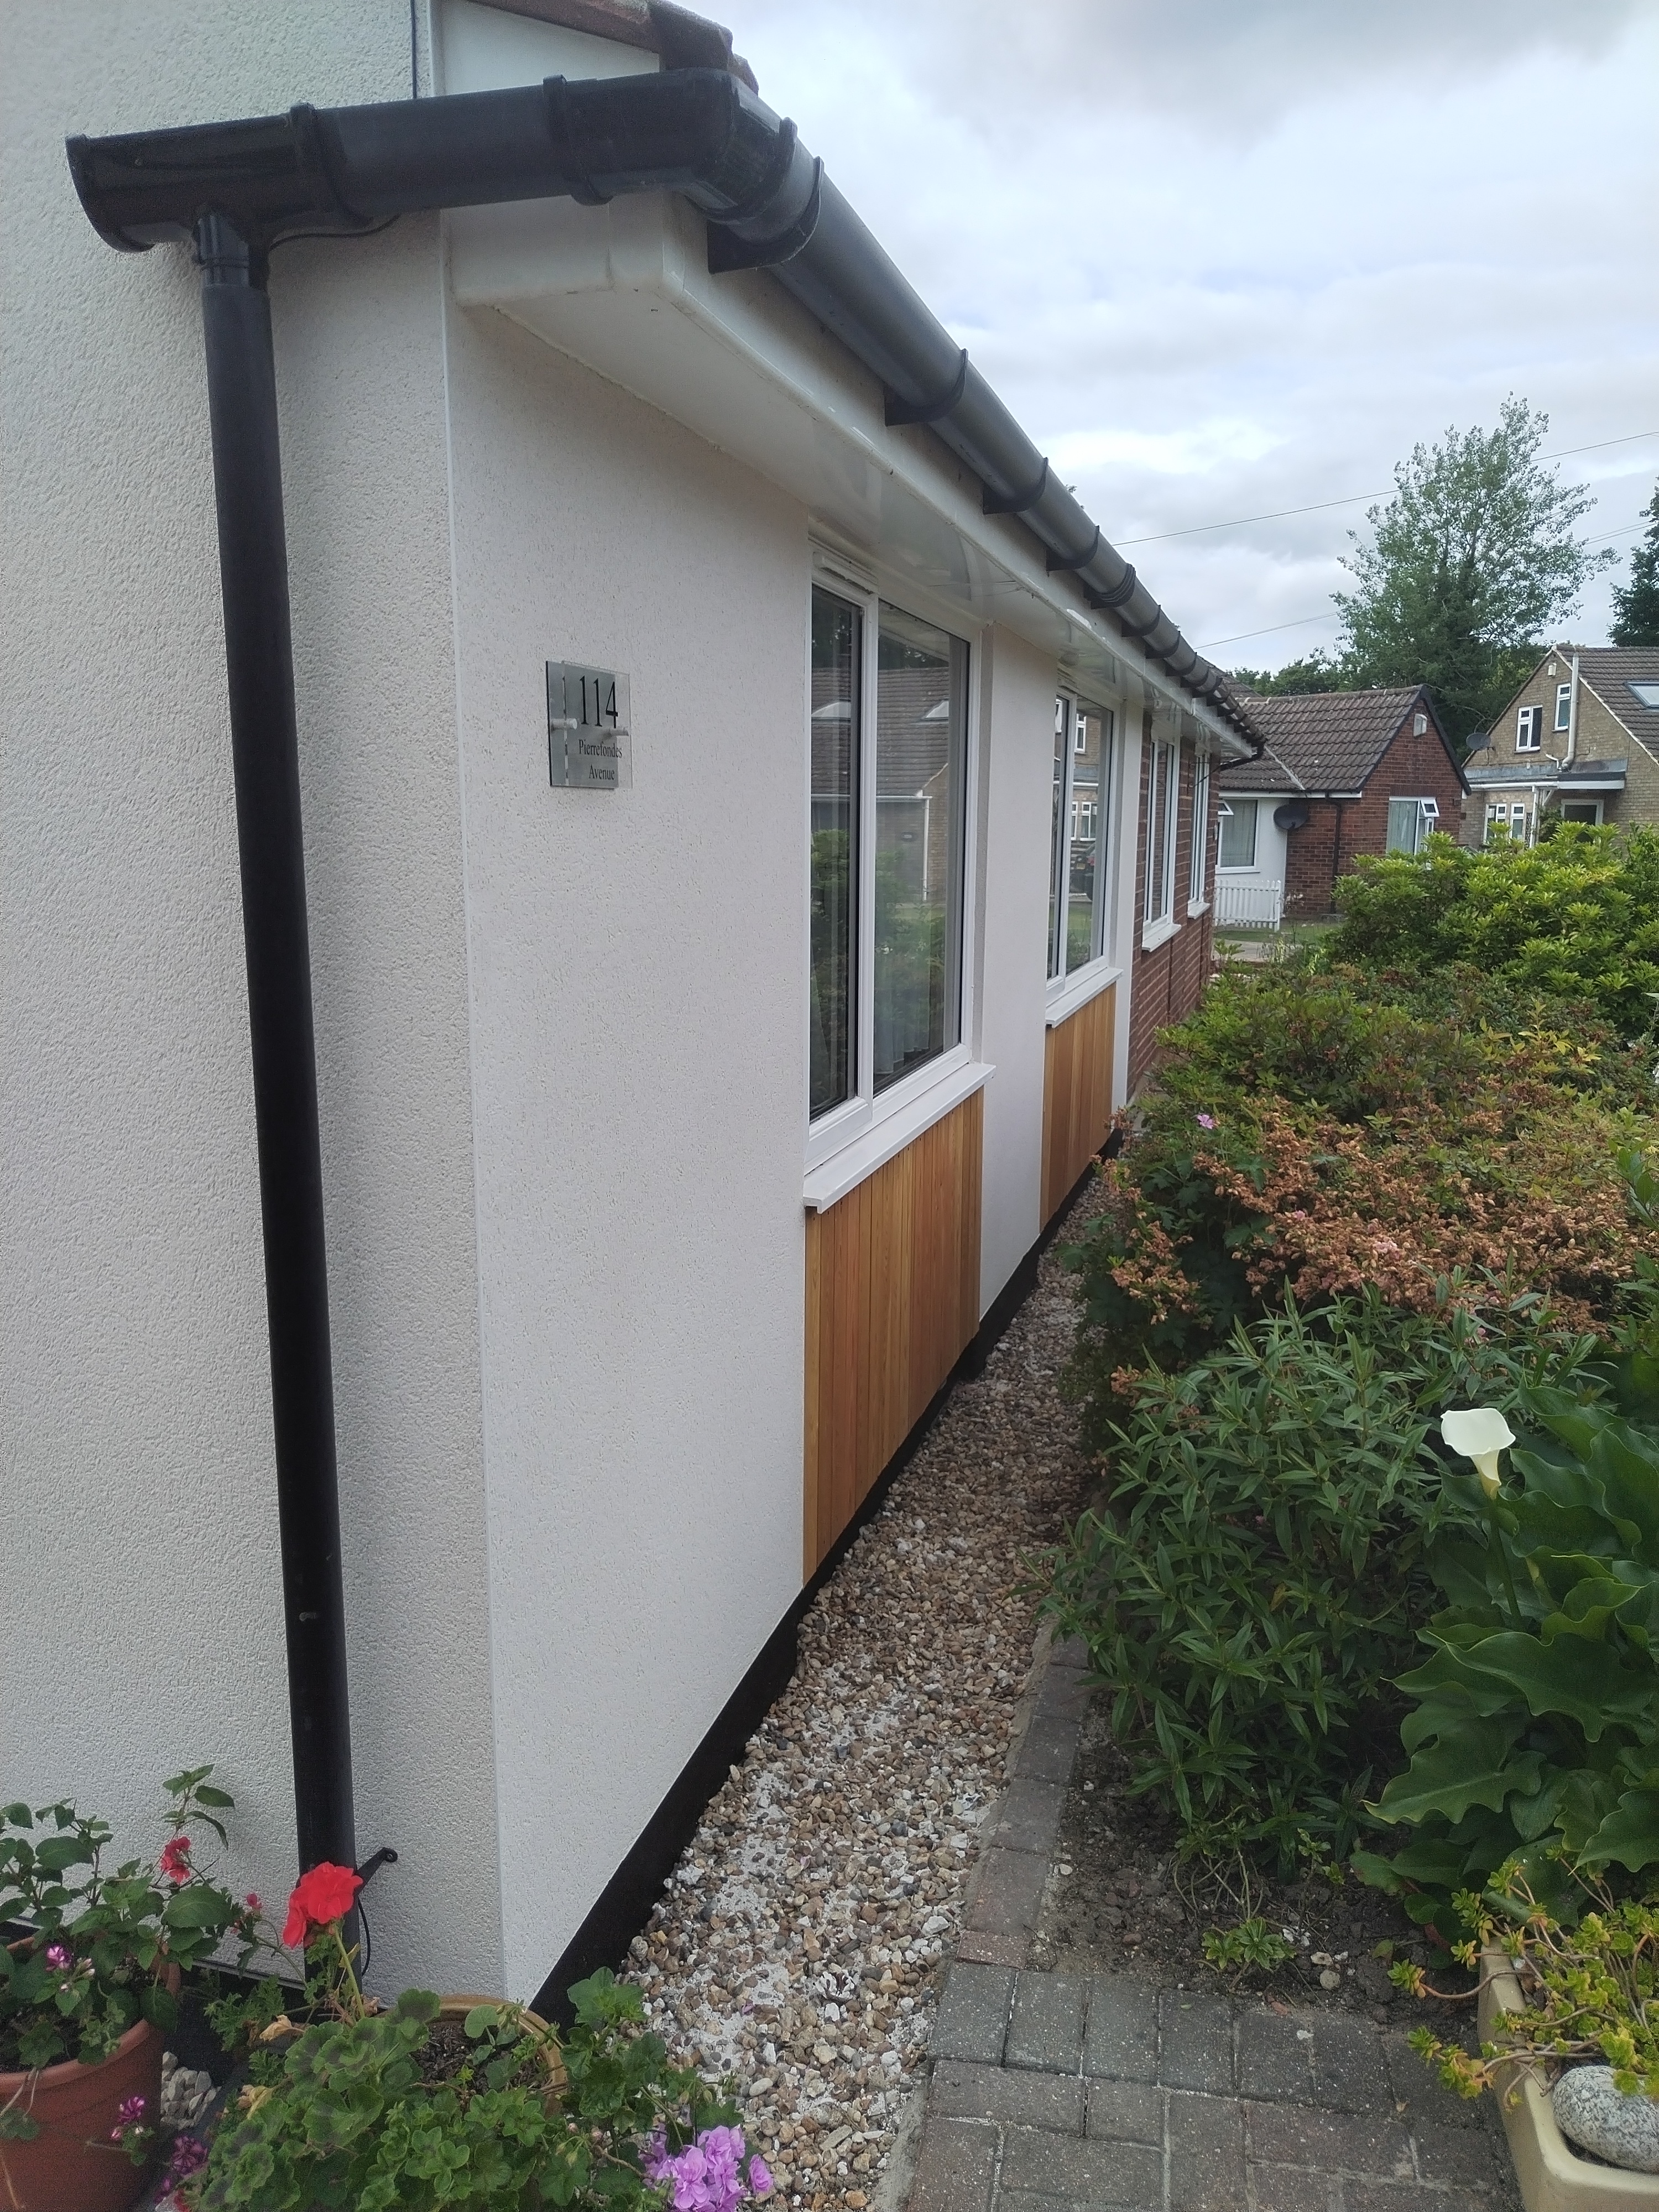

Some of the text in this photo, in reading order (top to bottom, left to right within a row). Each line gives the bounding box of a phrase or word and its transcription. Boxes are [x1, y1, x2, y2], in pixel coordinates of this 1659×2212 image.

[579, 675, 618, 728] 114
[578, 739, 622, 758] Pierrefondes
[588, 764, 615, 780] Avenue
